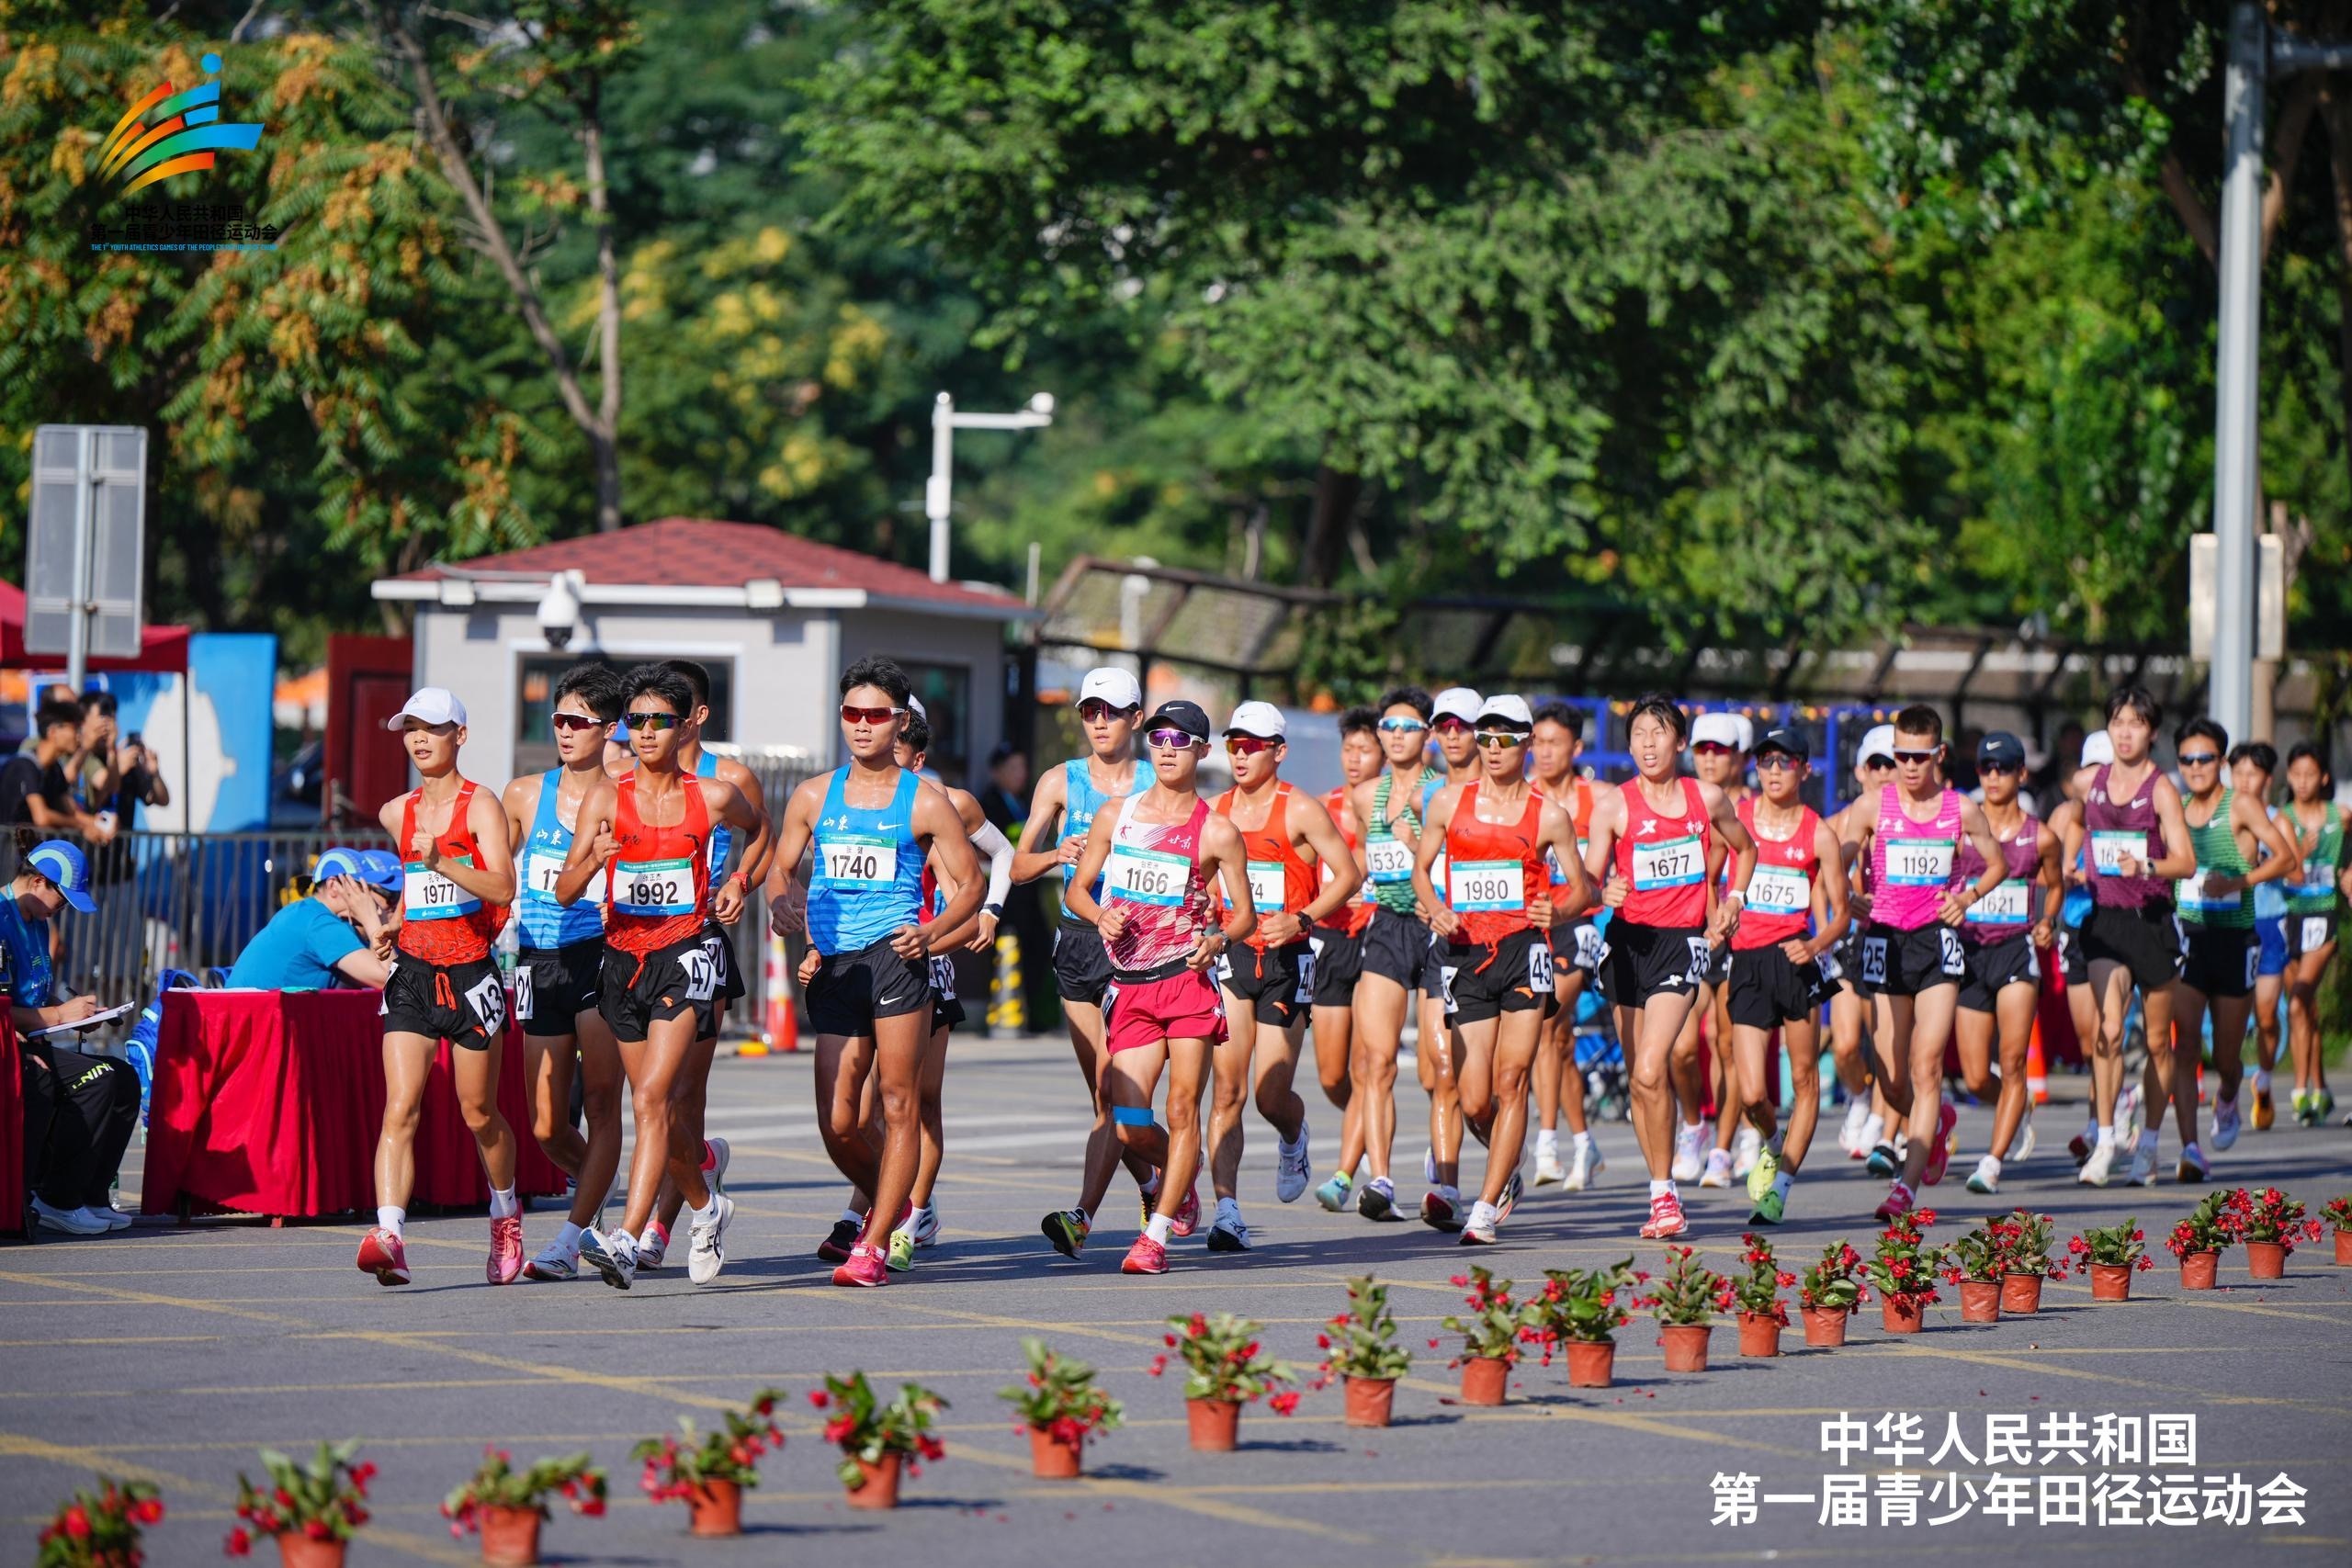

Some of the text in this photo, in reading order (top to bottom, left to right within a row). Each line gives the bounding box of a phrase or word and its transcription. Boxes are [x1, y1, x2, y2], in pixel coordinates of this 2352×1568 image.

[832, 854, 877, 879] 1740
[1368, 851, 1406, 871] 1532
[1649, 854, 1690, 878] 1677
[1903, 856, 1939, 875] 1192
[628, 881, 679, 906] 1992
[1126, 867, 1169, 895] 1166
[1464, 879, 1509, 901] 1980
[424, 884, 454, 904] 1977
[1755, 883, 1795, 905] 1675
[1981, 896, 2014, 914] 1621
[1691, 945, 1710, 977] 55
[1865, 945, 1884, 976] 25
[1944, 937, 1963, 967] 25
[691, 956, 711, 992] 47
[1532, 953, 1552, 986] 45
[478, 984, 503, 1024] 43
[516, 975, 532, 1012] 21
[72, 1063, 115, 1089] -NIN
